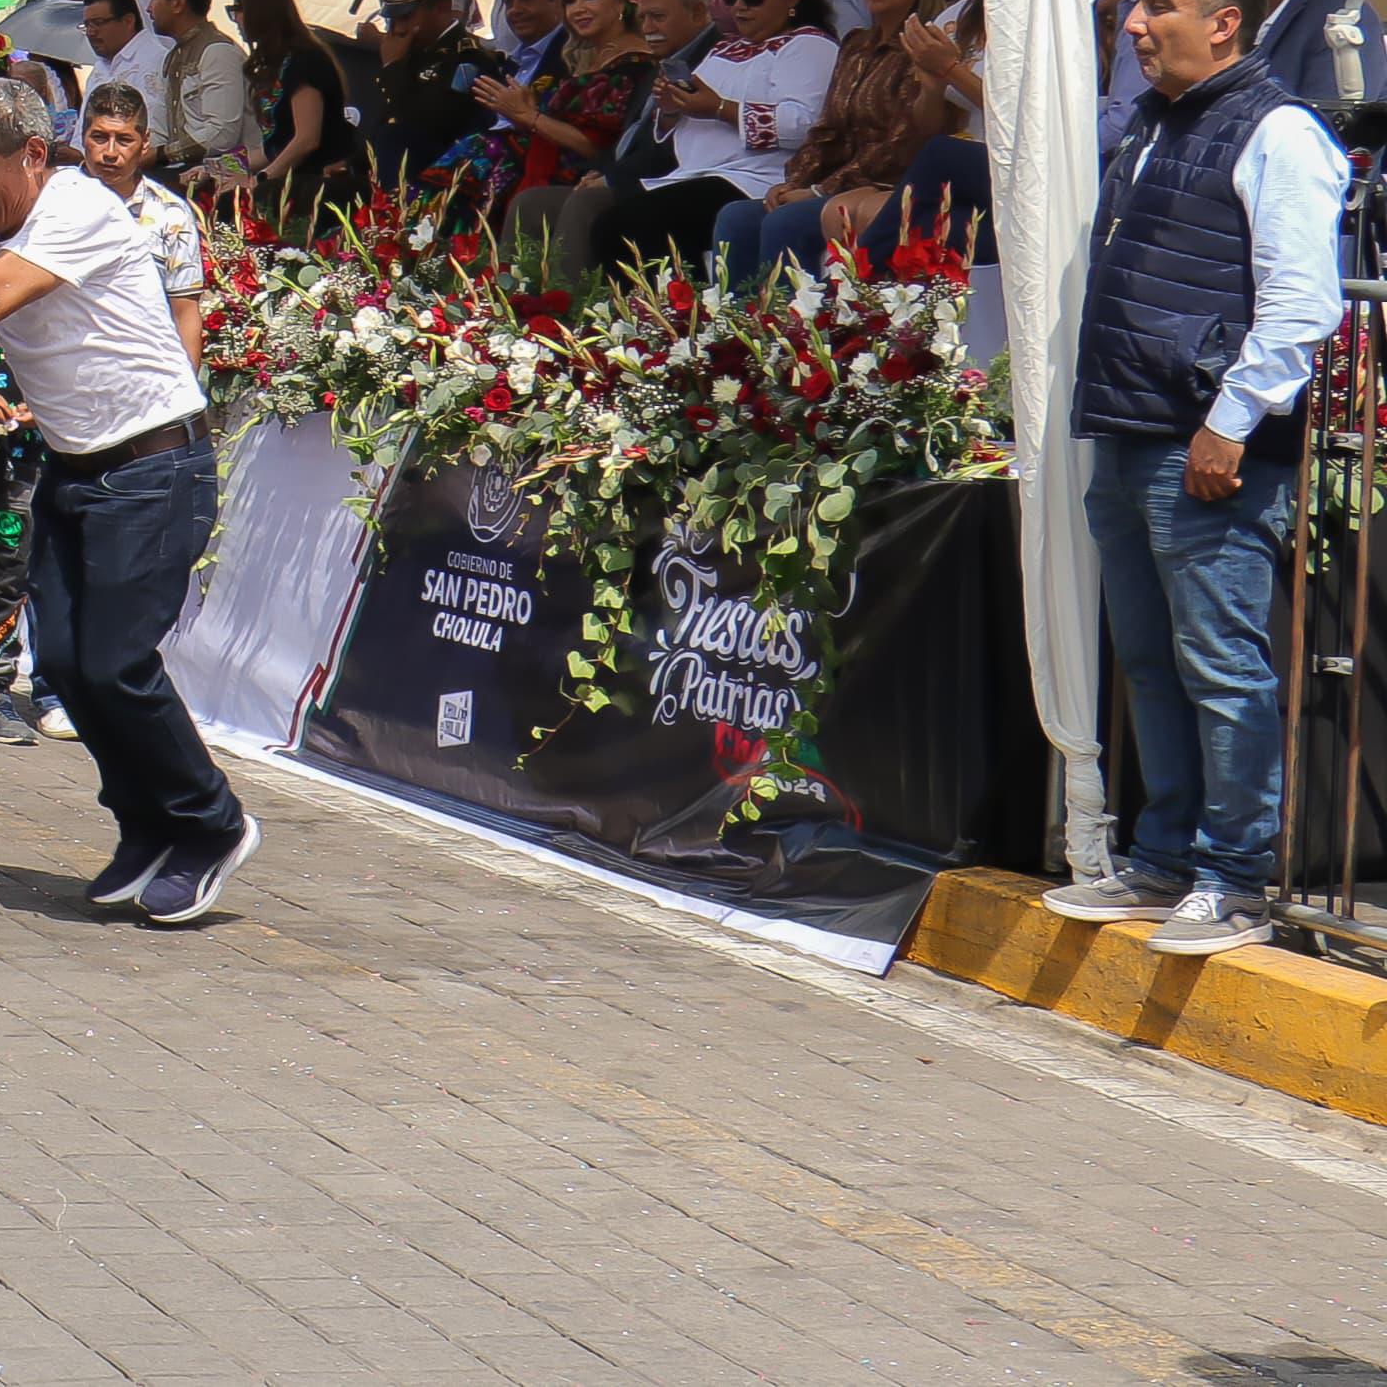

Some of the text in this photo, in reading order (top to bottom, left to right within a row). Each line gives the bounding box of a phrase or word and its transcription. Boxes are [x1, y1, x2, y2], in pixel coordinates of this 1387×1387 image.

[499, 562, 513, 581] DE
[421, 569, 532, 626] SAN PEDRO
[433, 612, 503, 652] CHOLULA
[654, 650, 790, 730] Patrias
[764, 774, 827, 803] 024
